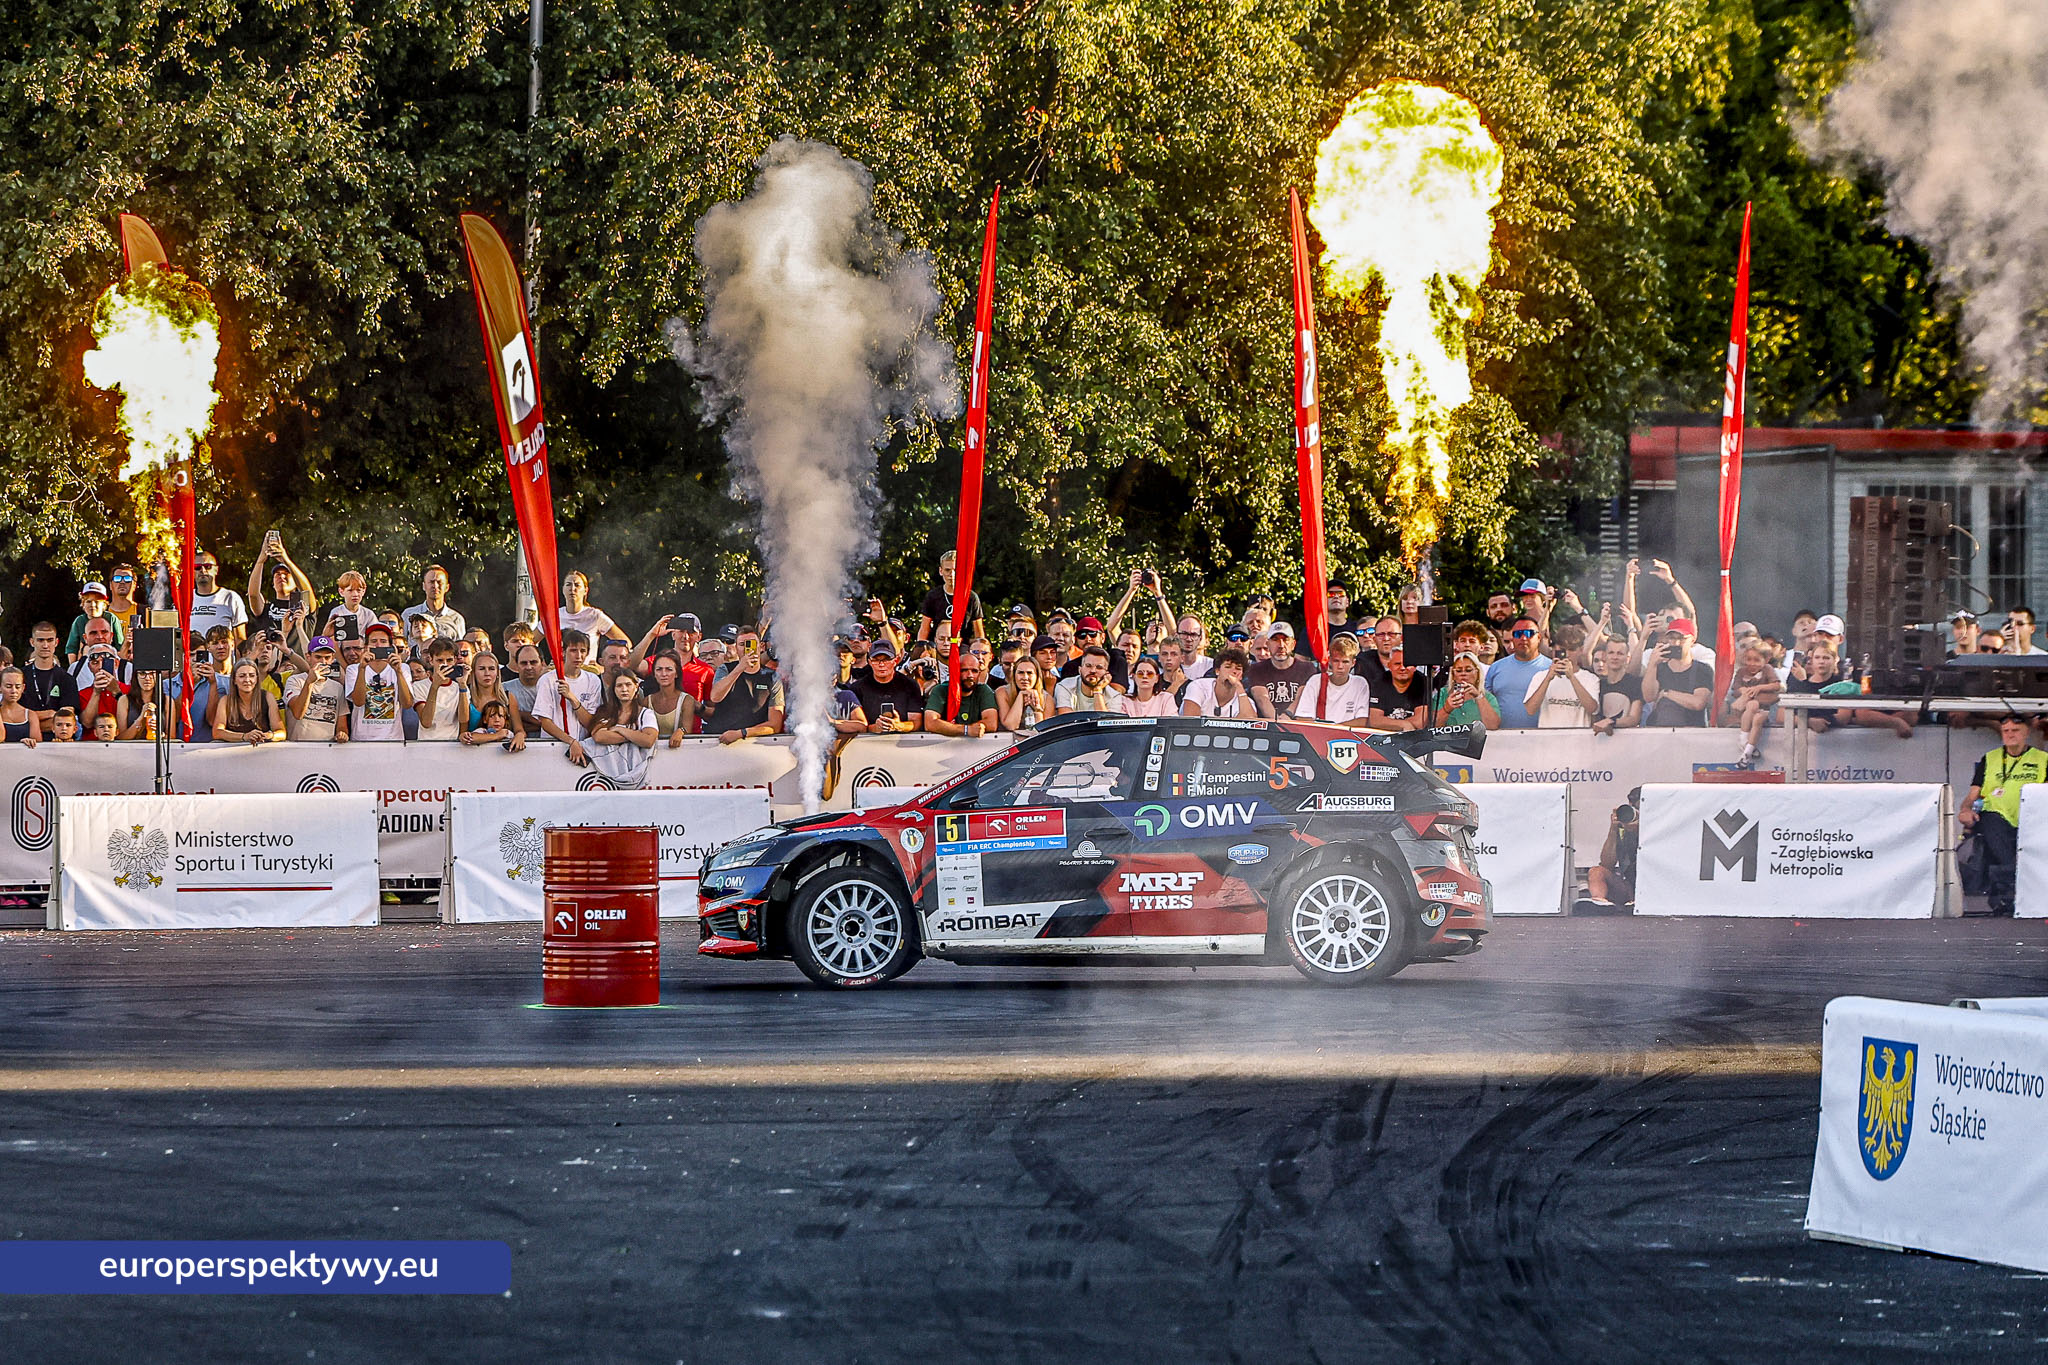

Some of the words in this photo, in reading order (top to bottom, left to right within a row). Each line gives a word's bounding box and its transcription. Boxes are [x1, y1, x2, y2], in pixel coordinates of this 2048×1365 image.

[1334, 747, 1355, 758] BT
[950, 769, 973, 787] RALLY
[975, 750, 1010, 772] ACADEMY
[1201, 771, 1266, 784] Tempestini
[1268, 757, 1290, 790] 5
[1492, 766, 1614, 784] Województwo
[1325, 796, 1392, 807] AUGSBURG
[1179, 801, 1259, 828] OMV
[945, 816, 959, 842] 5
[1015, 815, 1047, 824] ORLEN
[1771, 828, 1854, 845] Górnośląsko
[175, 830, 294, 848] Ministerstwo
[979, 842, 992, 850] ERC
[993, 840, 1036, 849] Championship
[174, 854, 235, 875] Sportu
[241, 854, 245, 871] i
[250, 853, 334, 874] Turystyki
[1769, 862, 1844, 879] Metropolia
[725, 876, 745, 887] OMV
[1118, 872, 1204, 893] MRF
[1129, 894, 1193, 910] TYRES
[584, 909, 626, 921] ORLEN
[937, 912, 1041, 933] ROMBAT
[584, 922, 601, 931] OIL
[1935, 1053, 2045, 1099] Województwo
[1930, 1097, 1987, 1145] Śląskie
